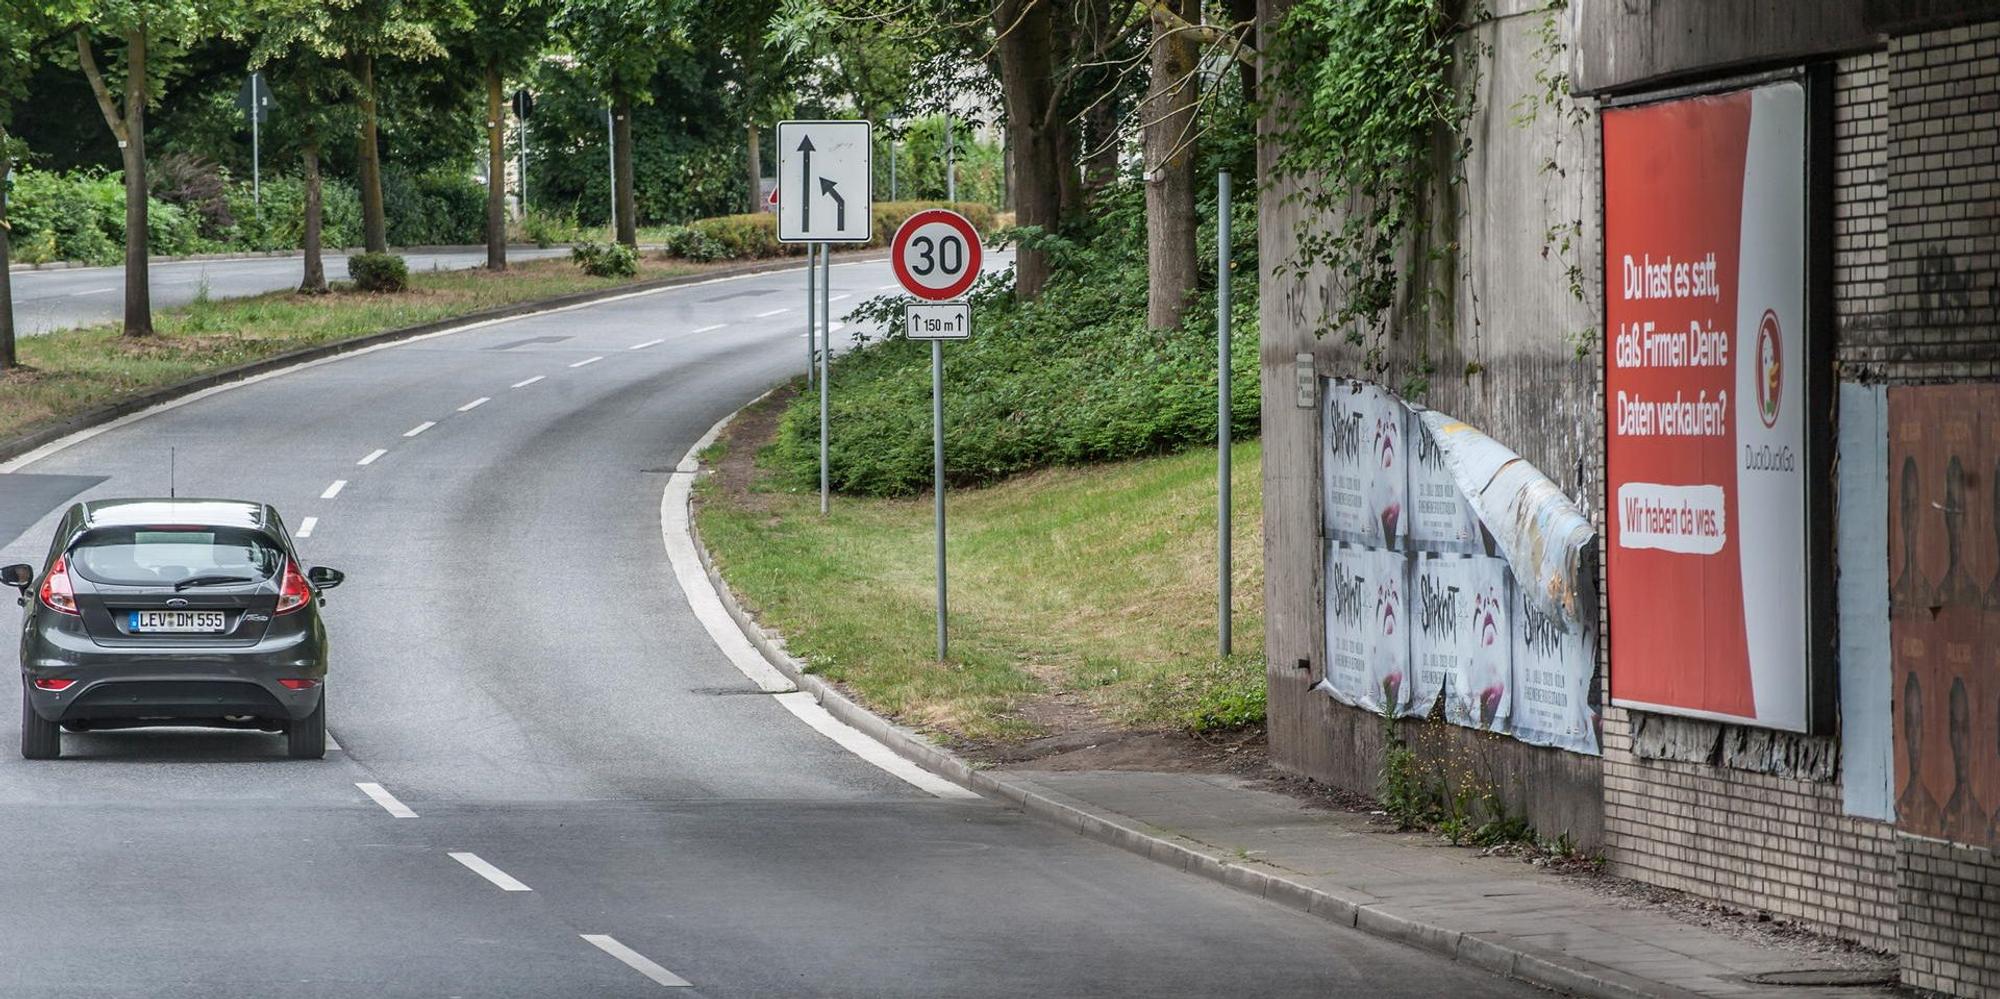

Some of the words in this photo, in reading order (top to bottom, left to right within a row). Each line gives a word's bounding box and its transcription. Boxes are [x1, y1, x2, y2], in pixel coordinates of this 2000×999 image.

[911, 235, 962, 276] 30
[1624, 254, 1642, 300] Du
[1645, 253, 1672, 299] hast
[1674, 262, 1690, 298] es
[1692, 252, 1720, 304] satt,
[924, 318, 941, 332] 150
[943, 321, 954, 332] m
[1616, 322, 1641, 368] daß
[1643, 321, 1687, 367] Firmen
[1691, 318, 1728, 367] Deine
[1617, 390, 1655, 436] Daten
[1657, 389, 1727, 436] verkaufen?
[1745, 444, 1795, 472] DuckDuckGo
[1625, 496, 1643, 533] Wir
[1645, 498, 1677, 534] haben
[1680, 499, 1693, 536] da
[1695, 507, 1719, 537] was.
[140, 612, 167, 627] LEV
[176, 612, 194, 627] DM
[197, 612, 223, 627] 555
